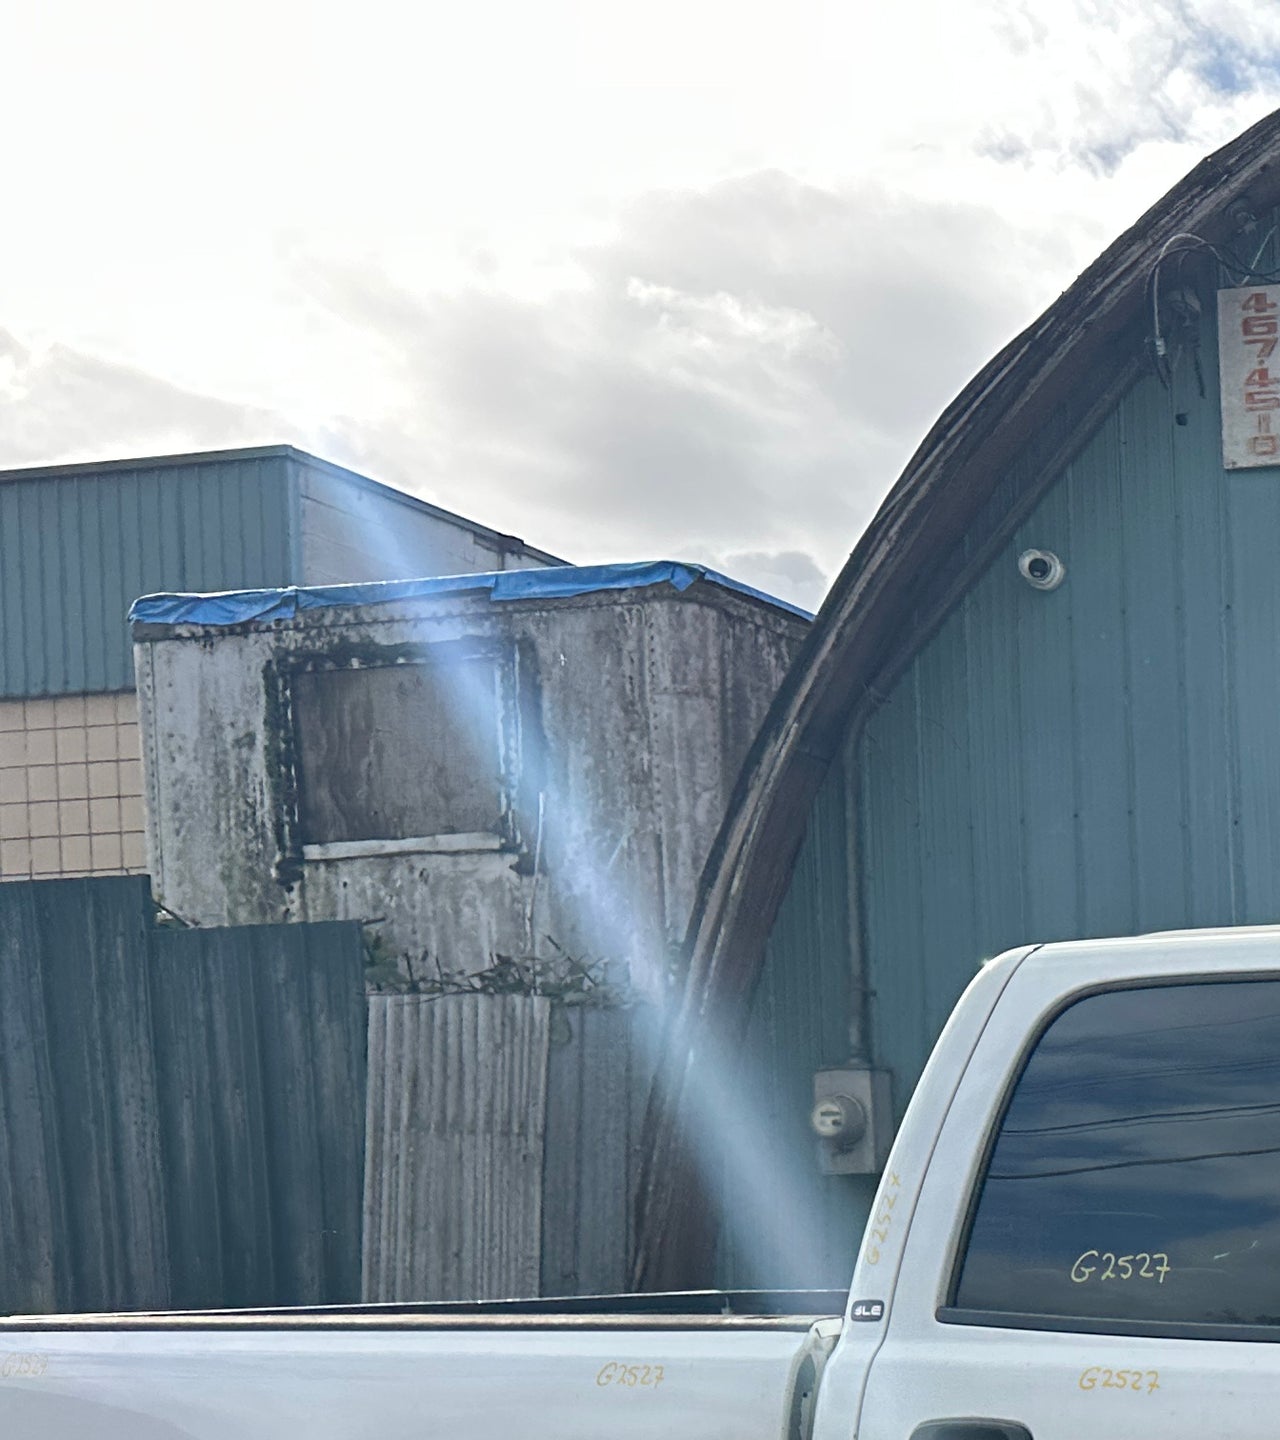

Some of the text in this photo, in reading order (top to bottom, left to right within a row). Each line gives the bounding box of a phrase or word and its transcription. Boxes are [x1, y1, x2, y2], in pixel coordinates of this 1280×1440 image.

[1070, 1250, 1171, 1284] G2527
[596, 1362, 665, 1389] G2527
[1078, 1366, 1160, 1395] G2527
